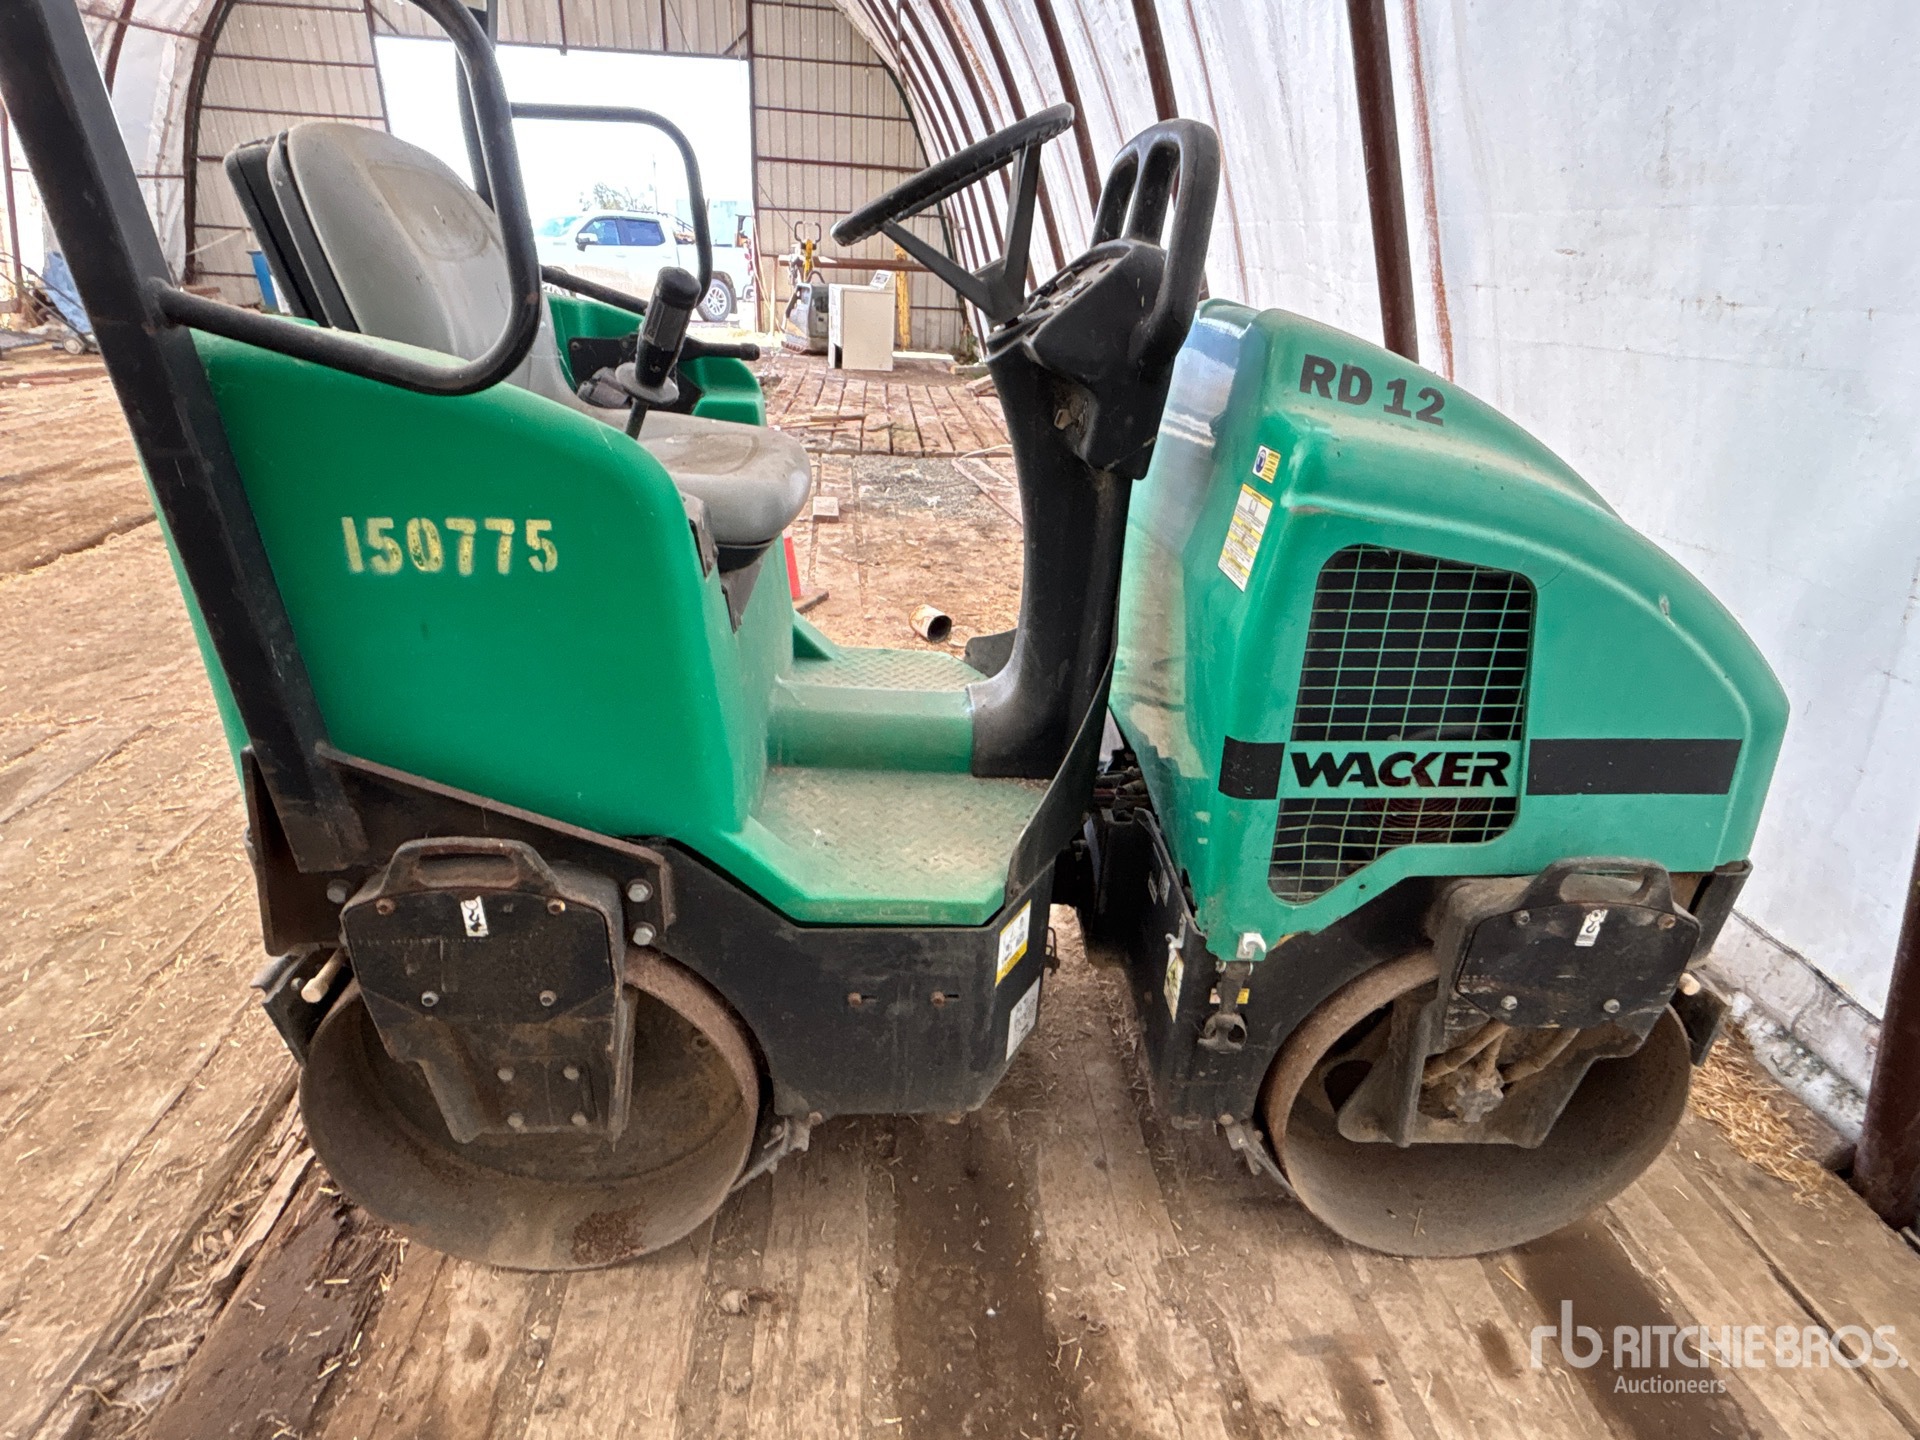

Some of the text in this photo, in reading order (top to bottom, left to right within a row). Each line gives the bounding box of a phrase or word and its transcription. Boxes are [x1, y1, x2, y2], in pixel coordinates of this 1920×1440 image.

[1299, 354, 1446, 427] RD 12
[341, 516, 558, 576] 150775
[1290, 751, 1511, 788] WACKER
